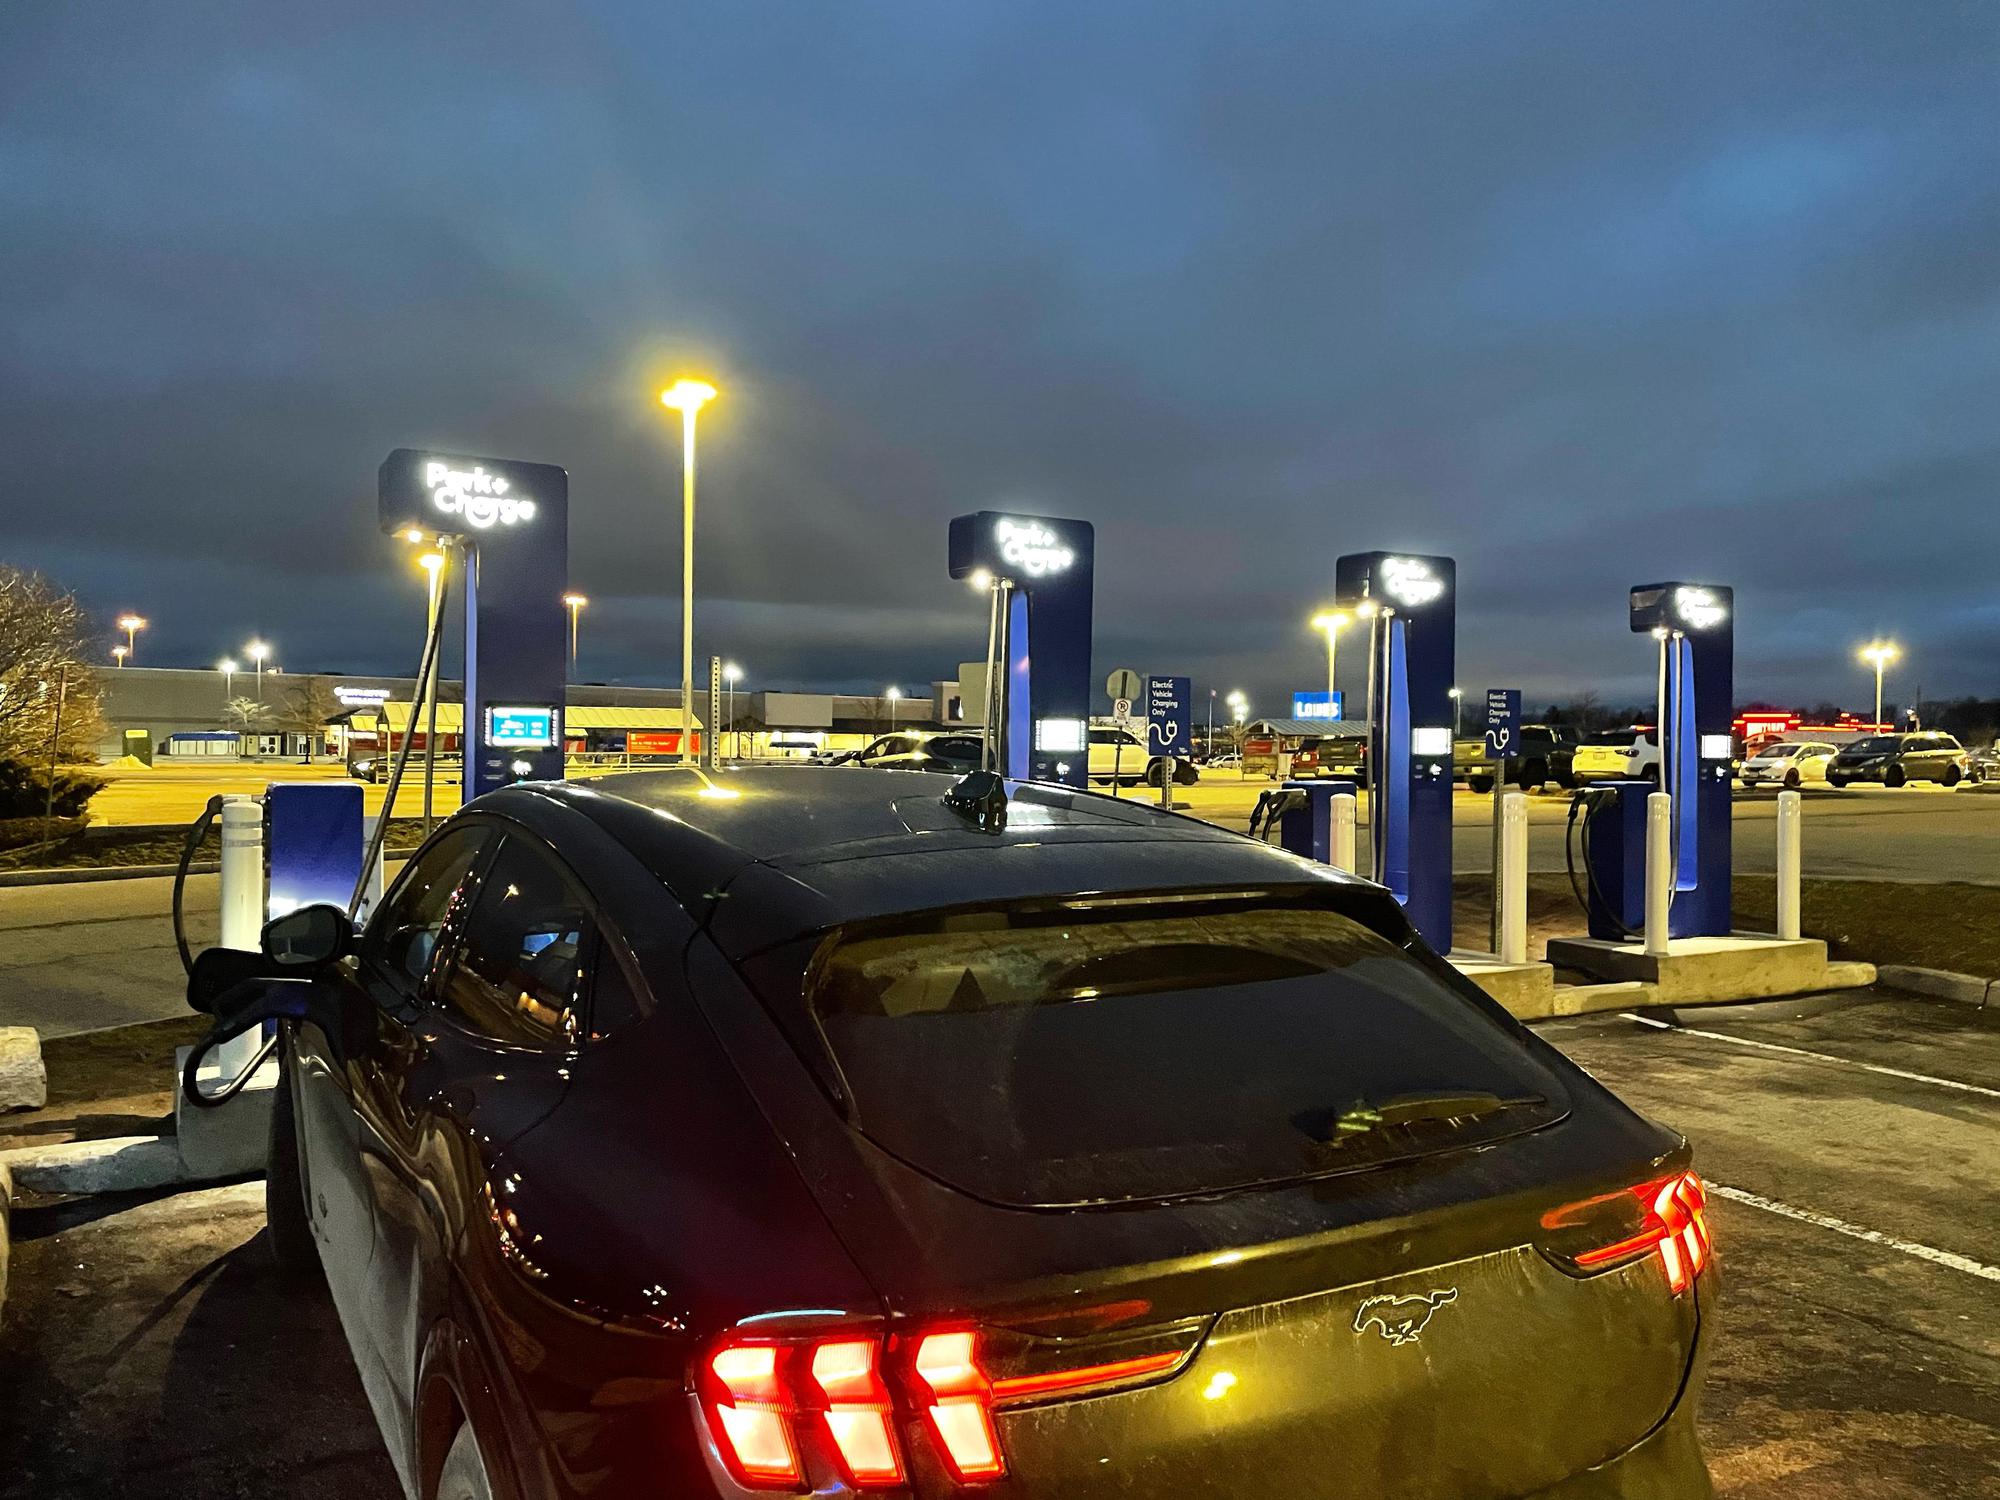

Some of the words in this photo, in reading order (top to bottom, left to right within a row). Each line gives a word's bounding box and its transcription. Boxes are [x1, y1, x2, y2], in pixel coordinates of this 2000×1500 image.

[434, 486, 535, 528] Charge
[1152, 680, 1173, 688] Electric
[1152, 699, 1178, 708] Charging
[1152, 708, 1165, 717] Only
